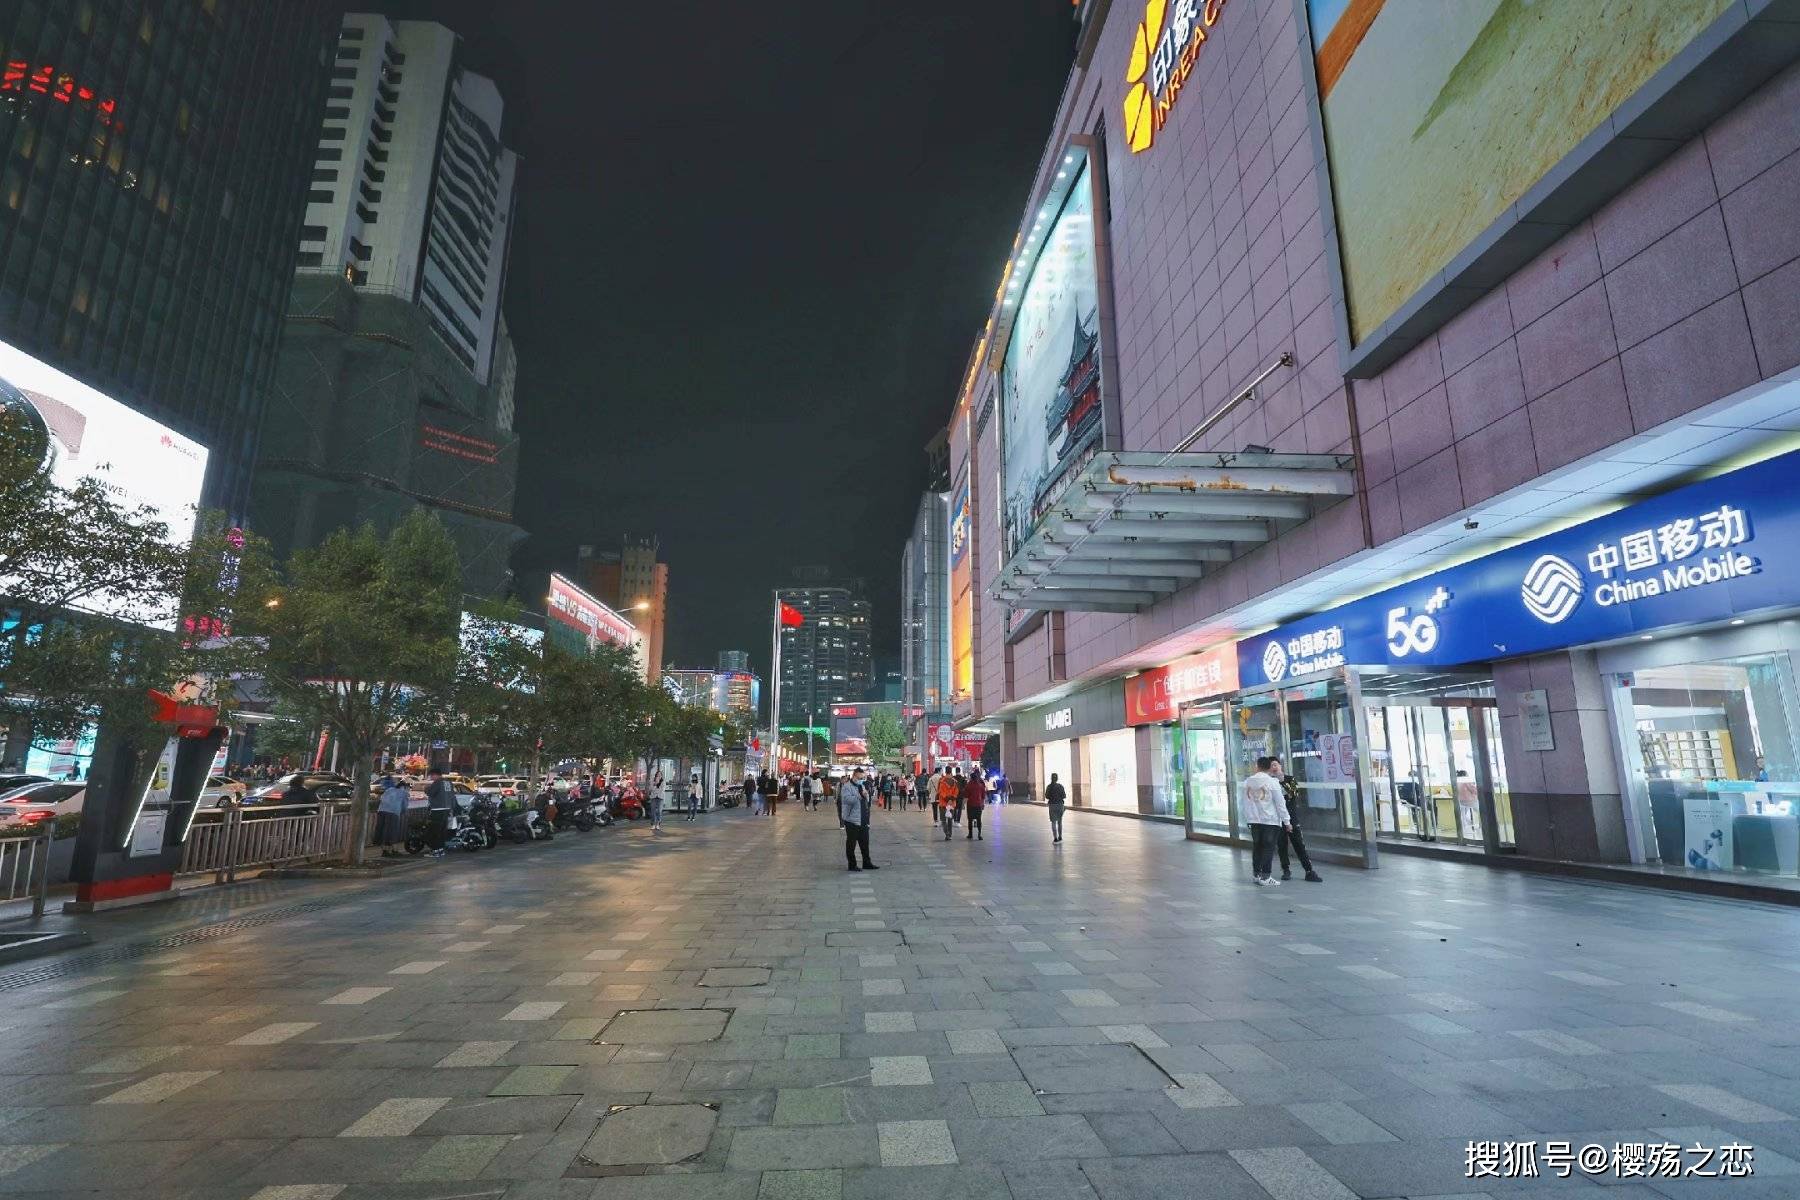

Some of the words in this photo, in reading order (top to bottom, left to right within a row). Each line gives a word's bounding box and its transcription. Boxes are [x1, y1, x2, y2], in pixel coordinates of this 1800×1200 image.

[1587, 504, 1748, 579] 中国移动
[1595, 564, 1660, 607] China
[1662, 551, 1753, 593] Mobile
[1287, 625, 1344, 658] 中国移动
[1289, 655, 1316, 677] China
[1313, 650, 1345, 673] Mobile
[1045, 707, 1072, 731] HUAWEI
